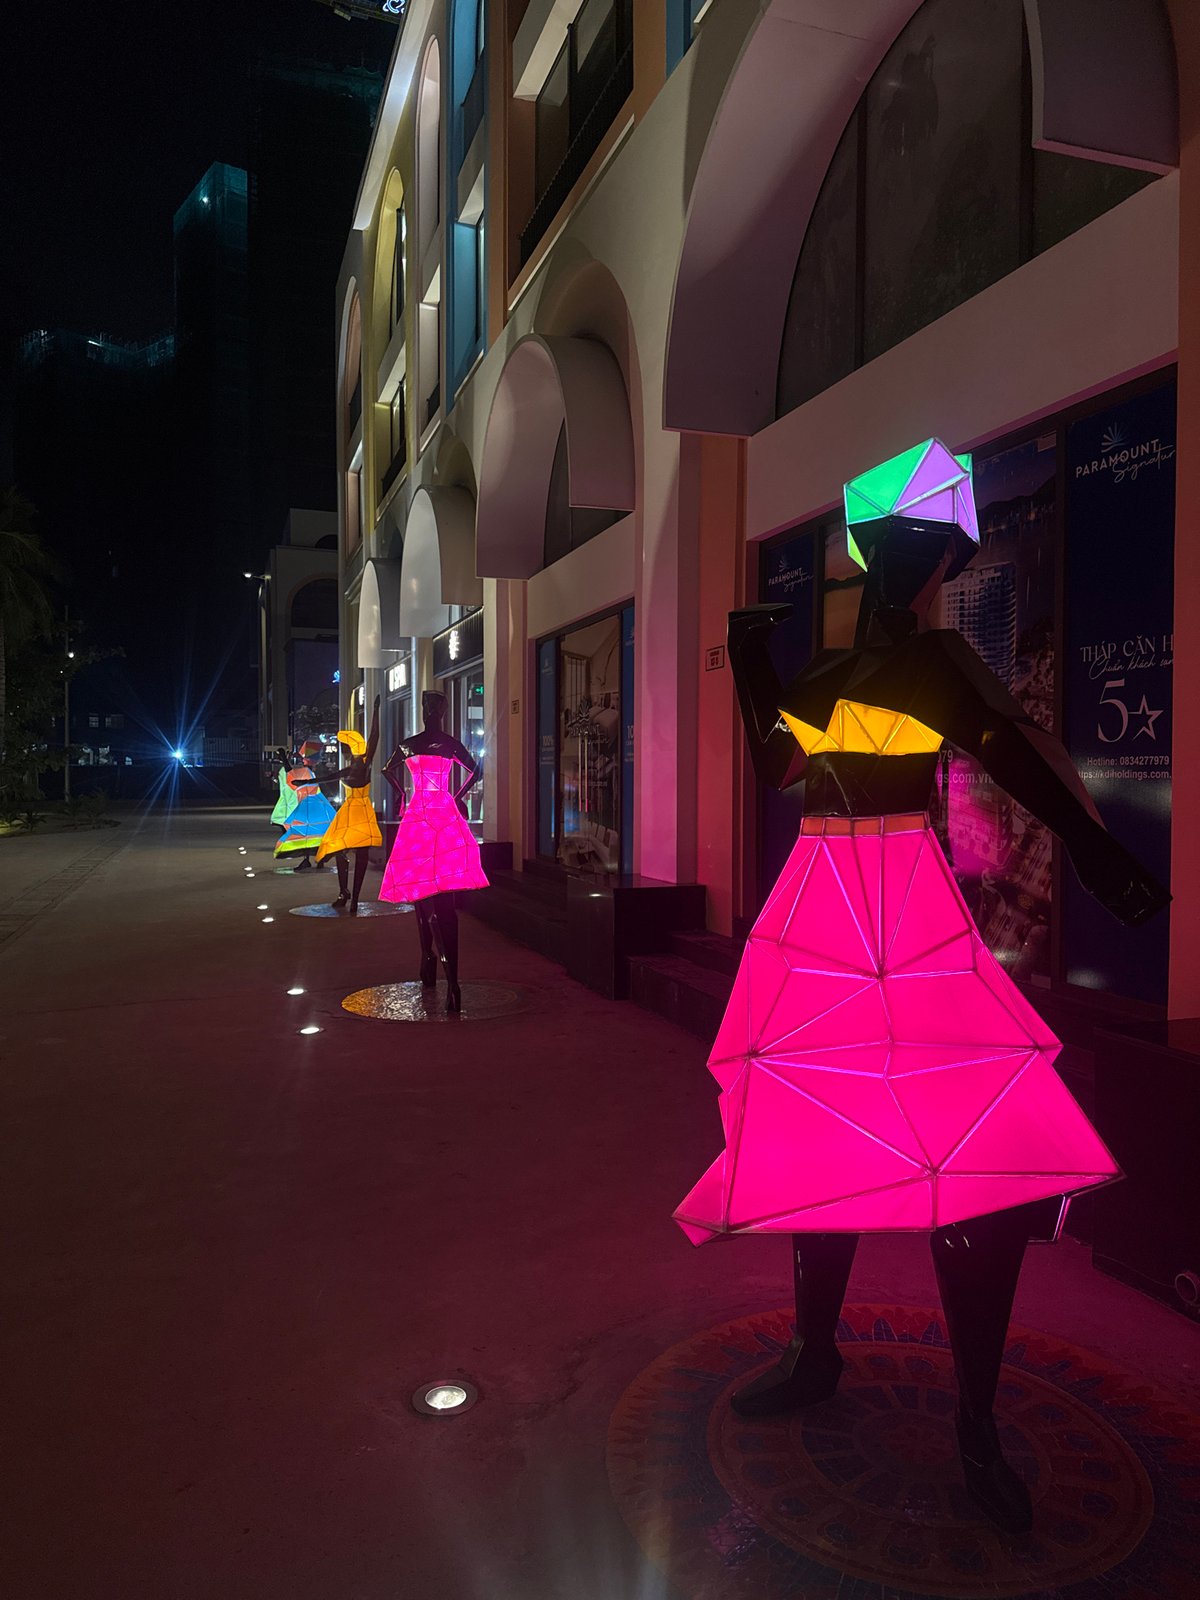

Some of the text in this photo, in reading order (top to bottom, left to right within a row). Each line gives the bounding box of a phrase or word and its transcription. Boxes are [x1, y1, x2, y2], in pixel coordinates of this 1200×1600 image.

[1076, 438, 1160, 479] PARAMOUNT
[1123, 634, 1156, 657] CĂN
[1097, 678, 1129, 743] 5
[1119, 755, 1170, 766] 0834277979
